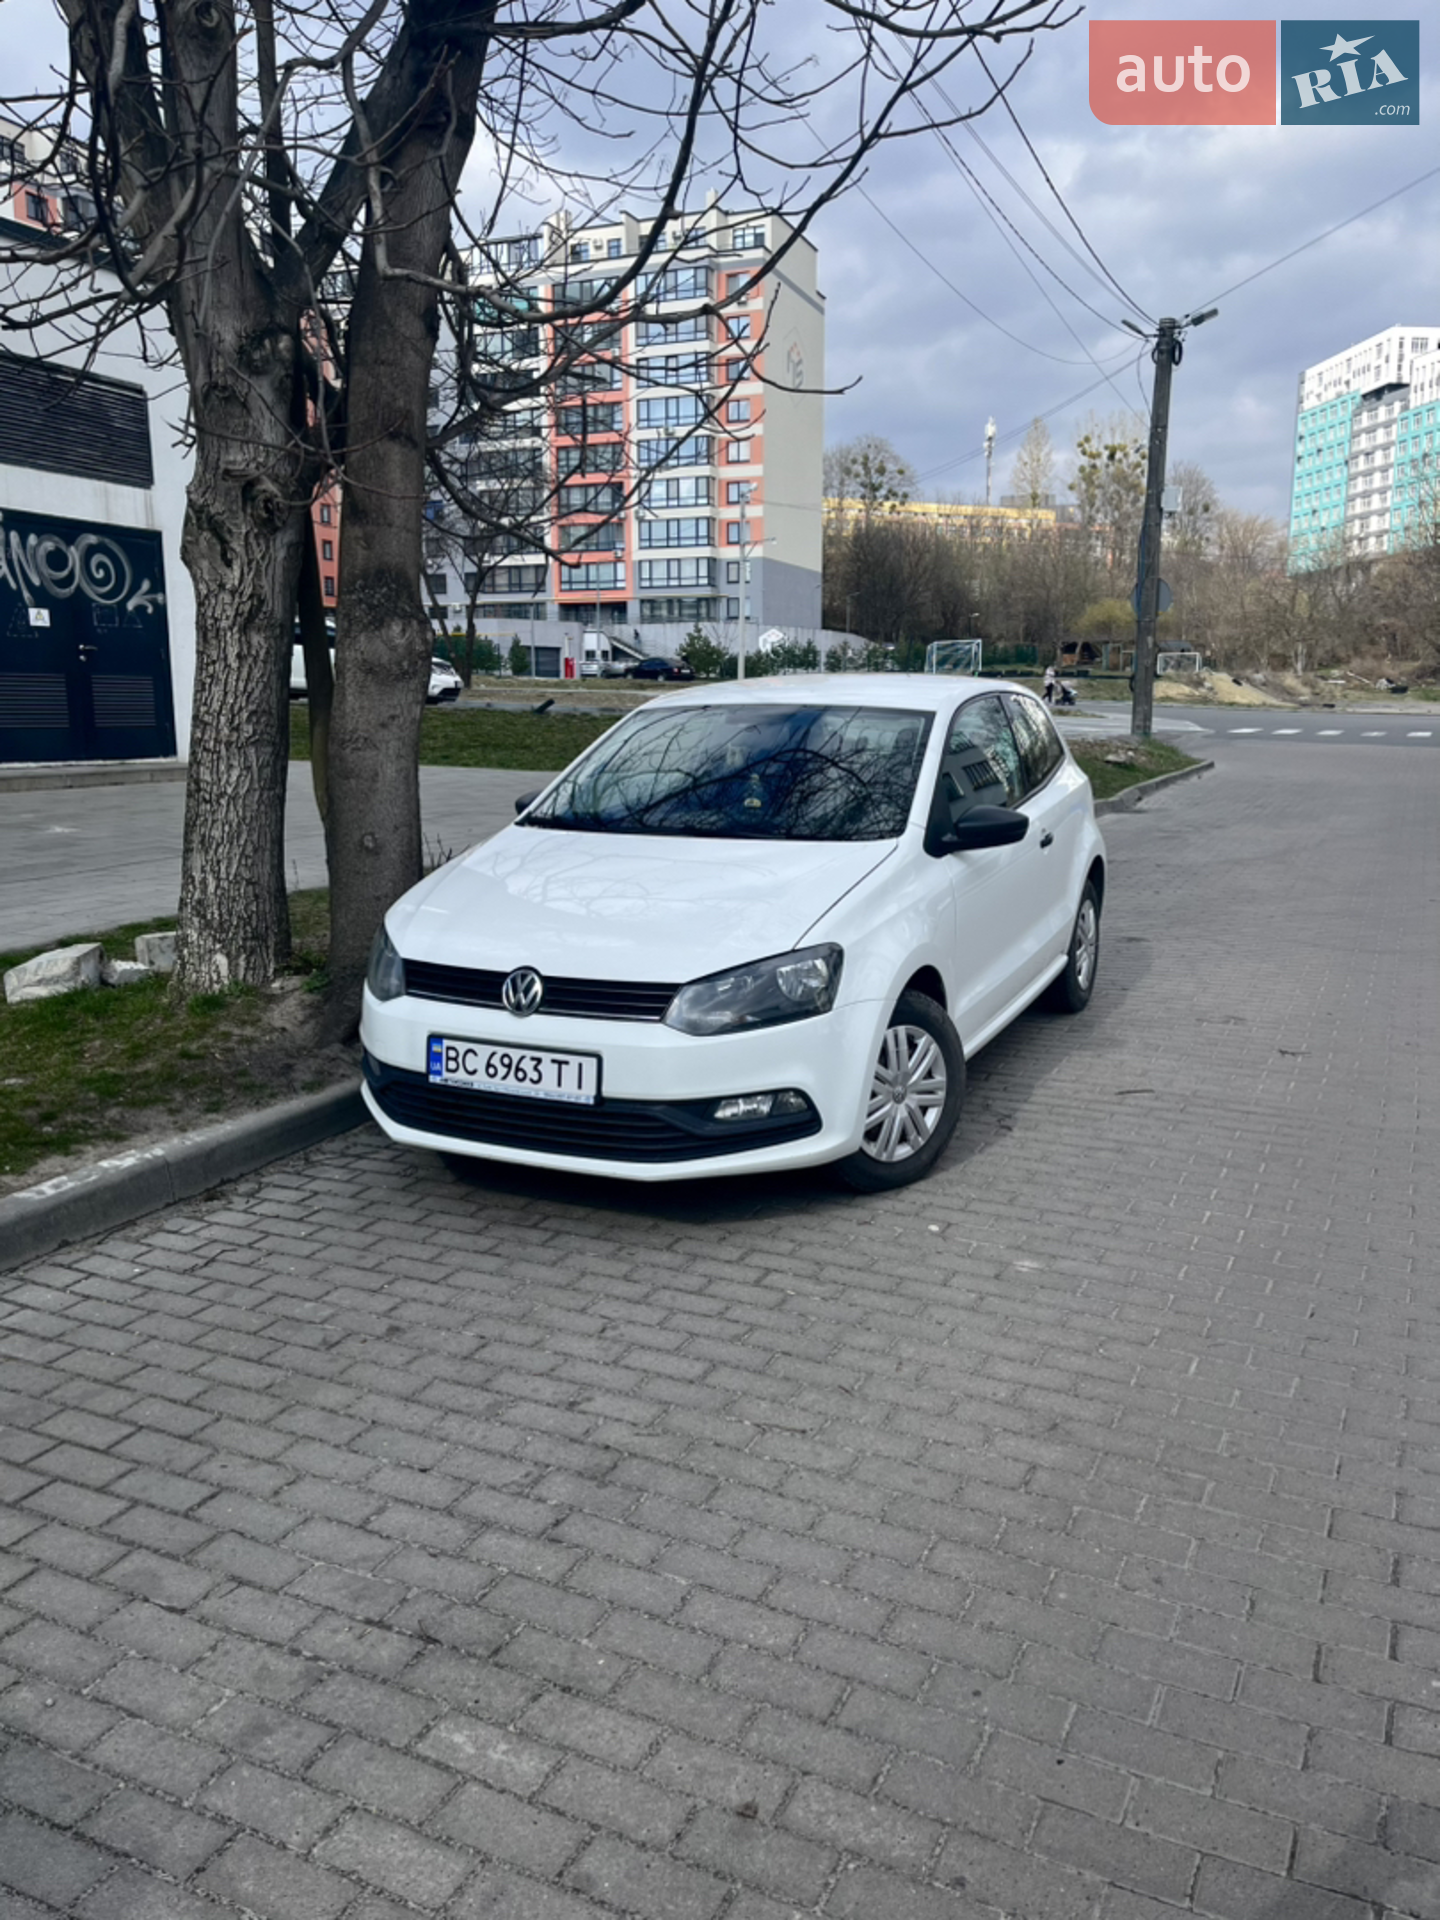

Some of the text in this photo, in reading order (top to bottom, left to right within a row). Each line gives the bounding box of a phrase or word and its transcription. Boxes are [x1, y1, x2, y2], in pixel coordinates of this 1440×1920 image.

[445, 1046, 583, 1090] BC 6963 TI
